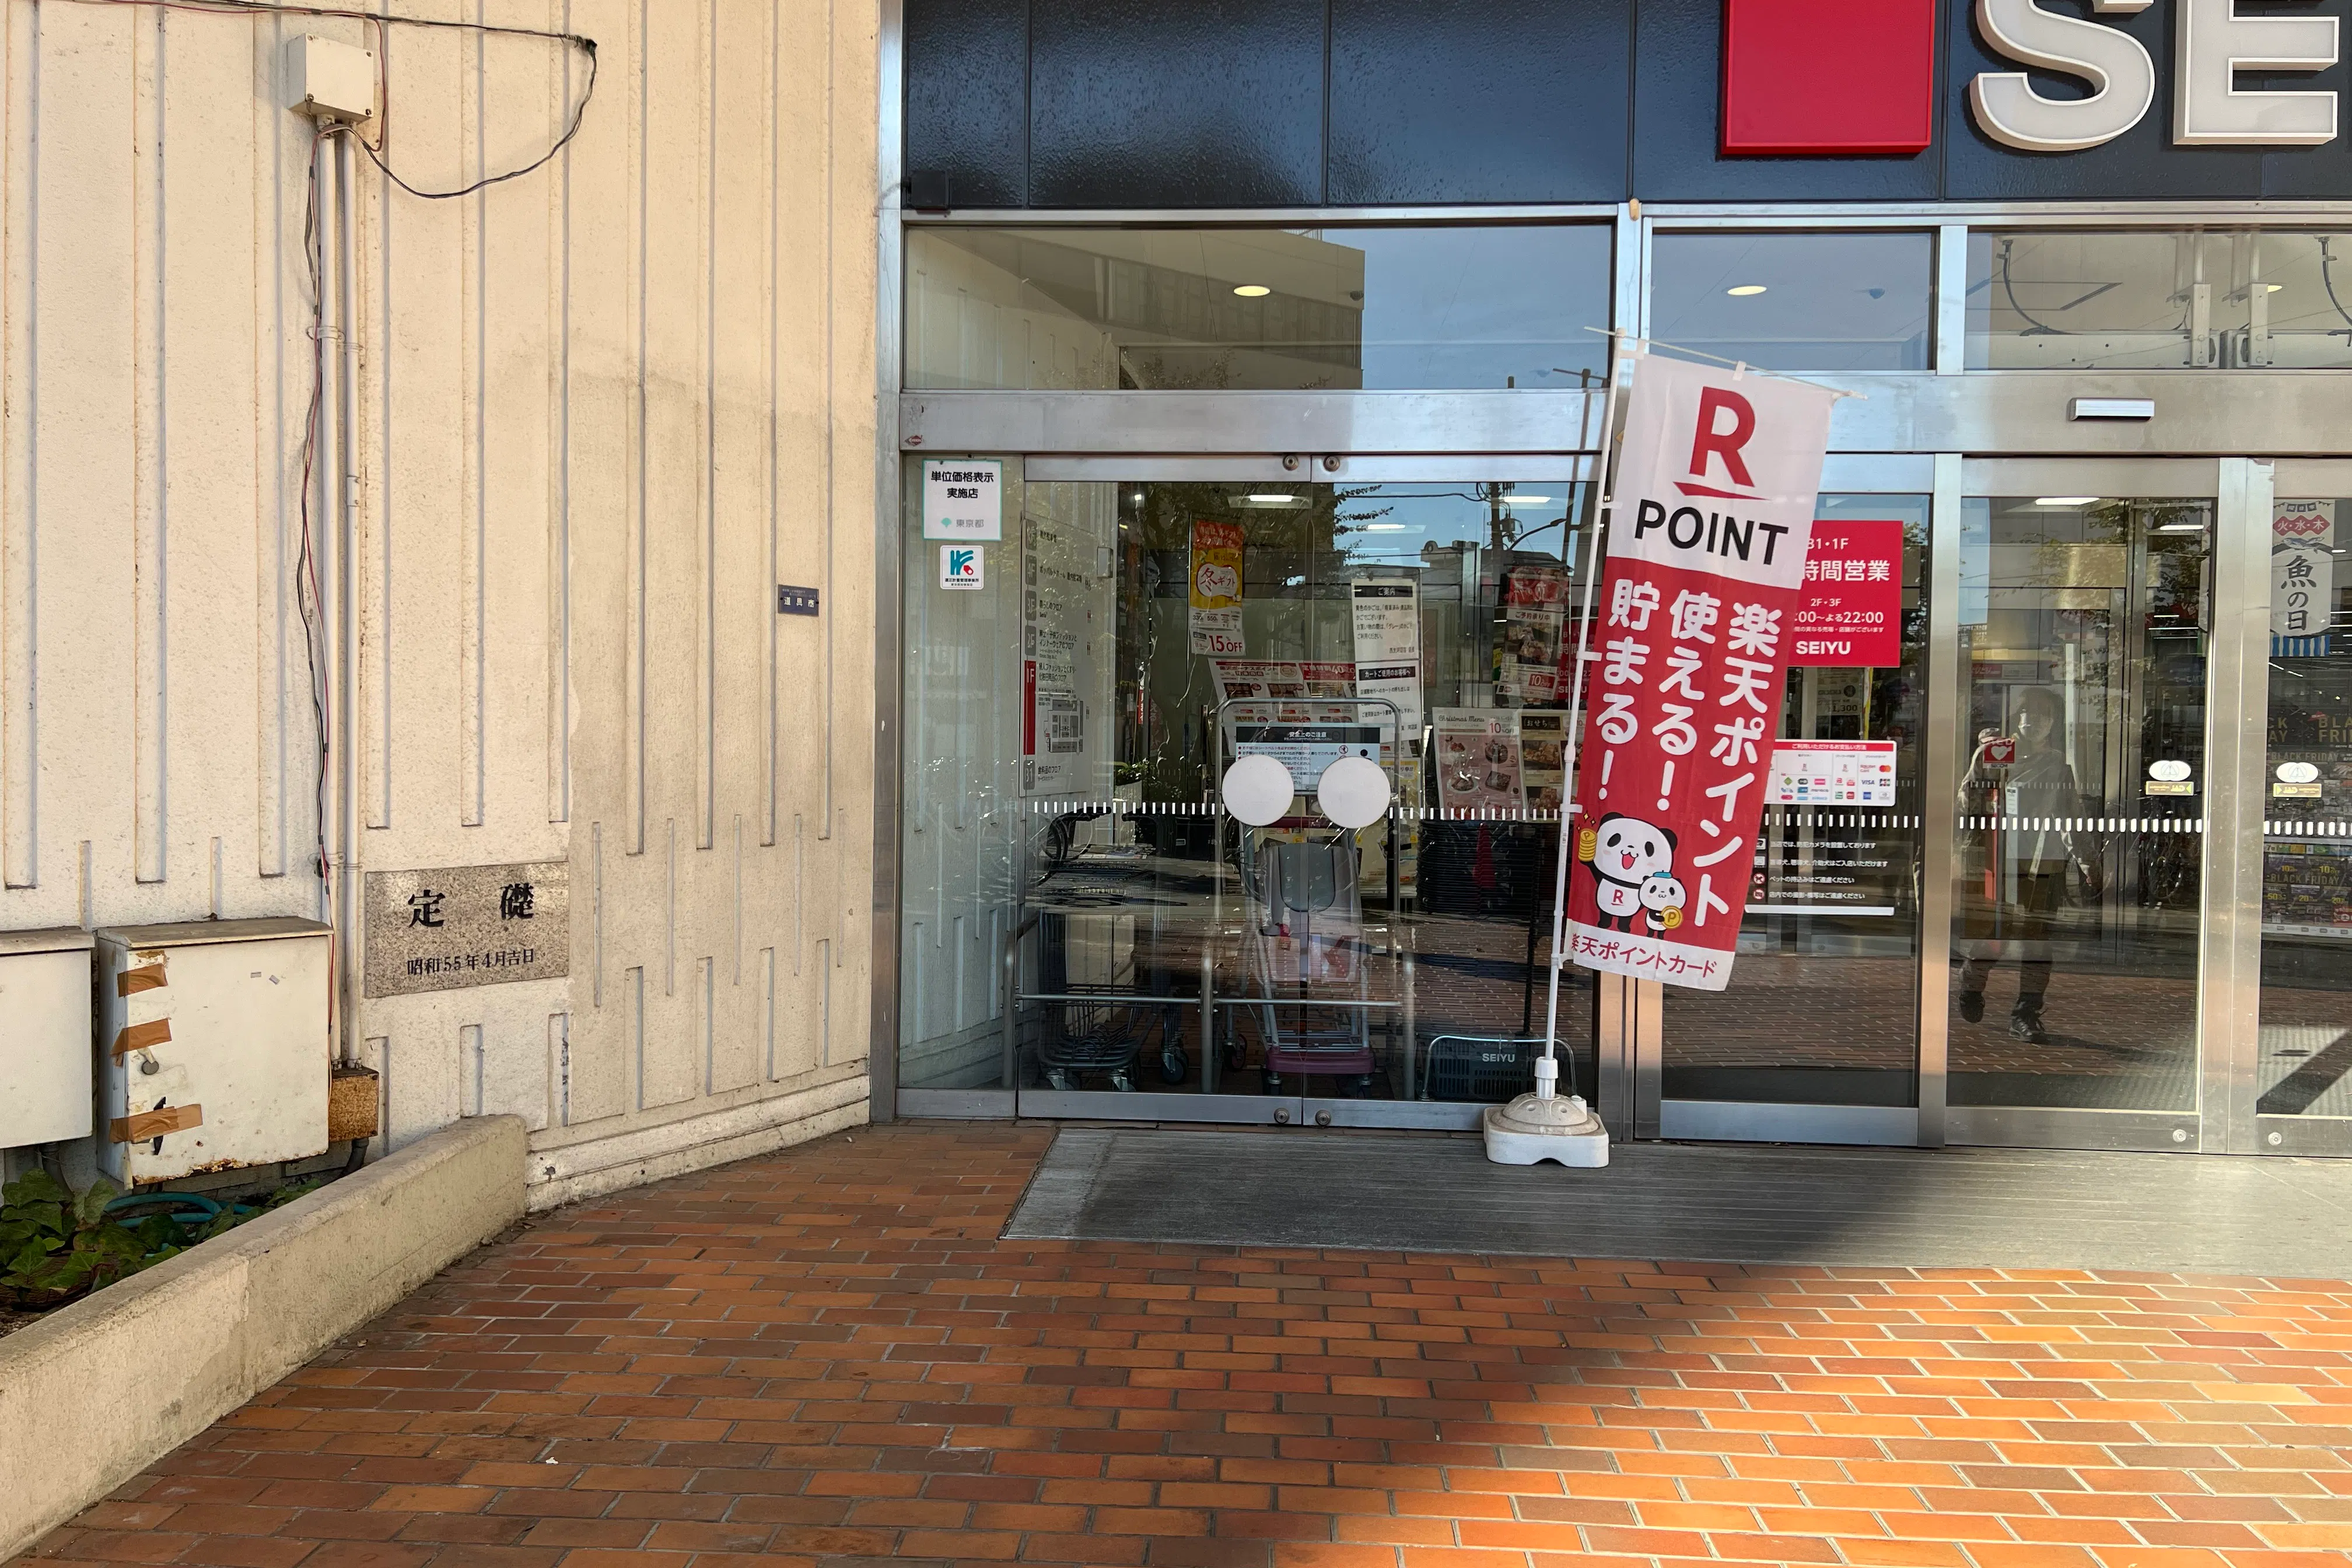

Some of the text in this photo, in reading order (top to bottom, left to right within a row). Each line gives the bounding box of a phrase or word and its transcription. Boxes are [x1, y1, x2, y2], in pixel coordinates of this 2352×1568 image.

[1689, 386, 1756, 488] R
[930, 471, 994, 483] 単位価格表示
[947, 488, 978, 498] 実施店
[956, 519, 984, 528] 東京都
[2277, 519, 2325, 531] 火・水・木
[1634, 499, 1789, 566] POINT
[1199, 567, 1236, 592] 冬ギフト
[1378, 587, 1395, 596] ご案内
[2281, 555, 2317, 631] 魚の日
[1810, 598, 1842, 607] 2F・3F
[1515, 612, 1550, 621] ご予約承り中
[1796, 640, 1851, 654] SEIYU
[1438, 715, 1468, 723] Christmas
[1527, 719, 1548, 727] おせち
[1694, 601, 1782, 928] 楽天ポイント
[1612, 889, 1625, 904] R
[408, 883, 534, 928] 定礎
[1667, 911, 1677, 924] P
[407, 948, 534, 976] 昭和55年4月吉日
[1482, 1052, 1516, 1063] SEIYU
